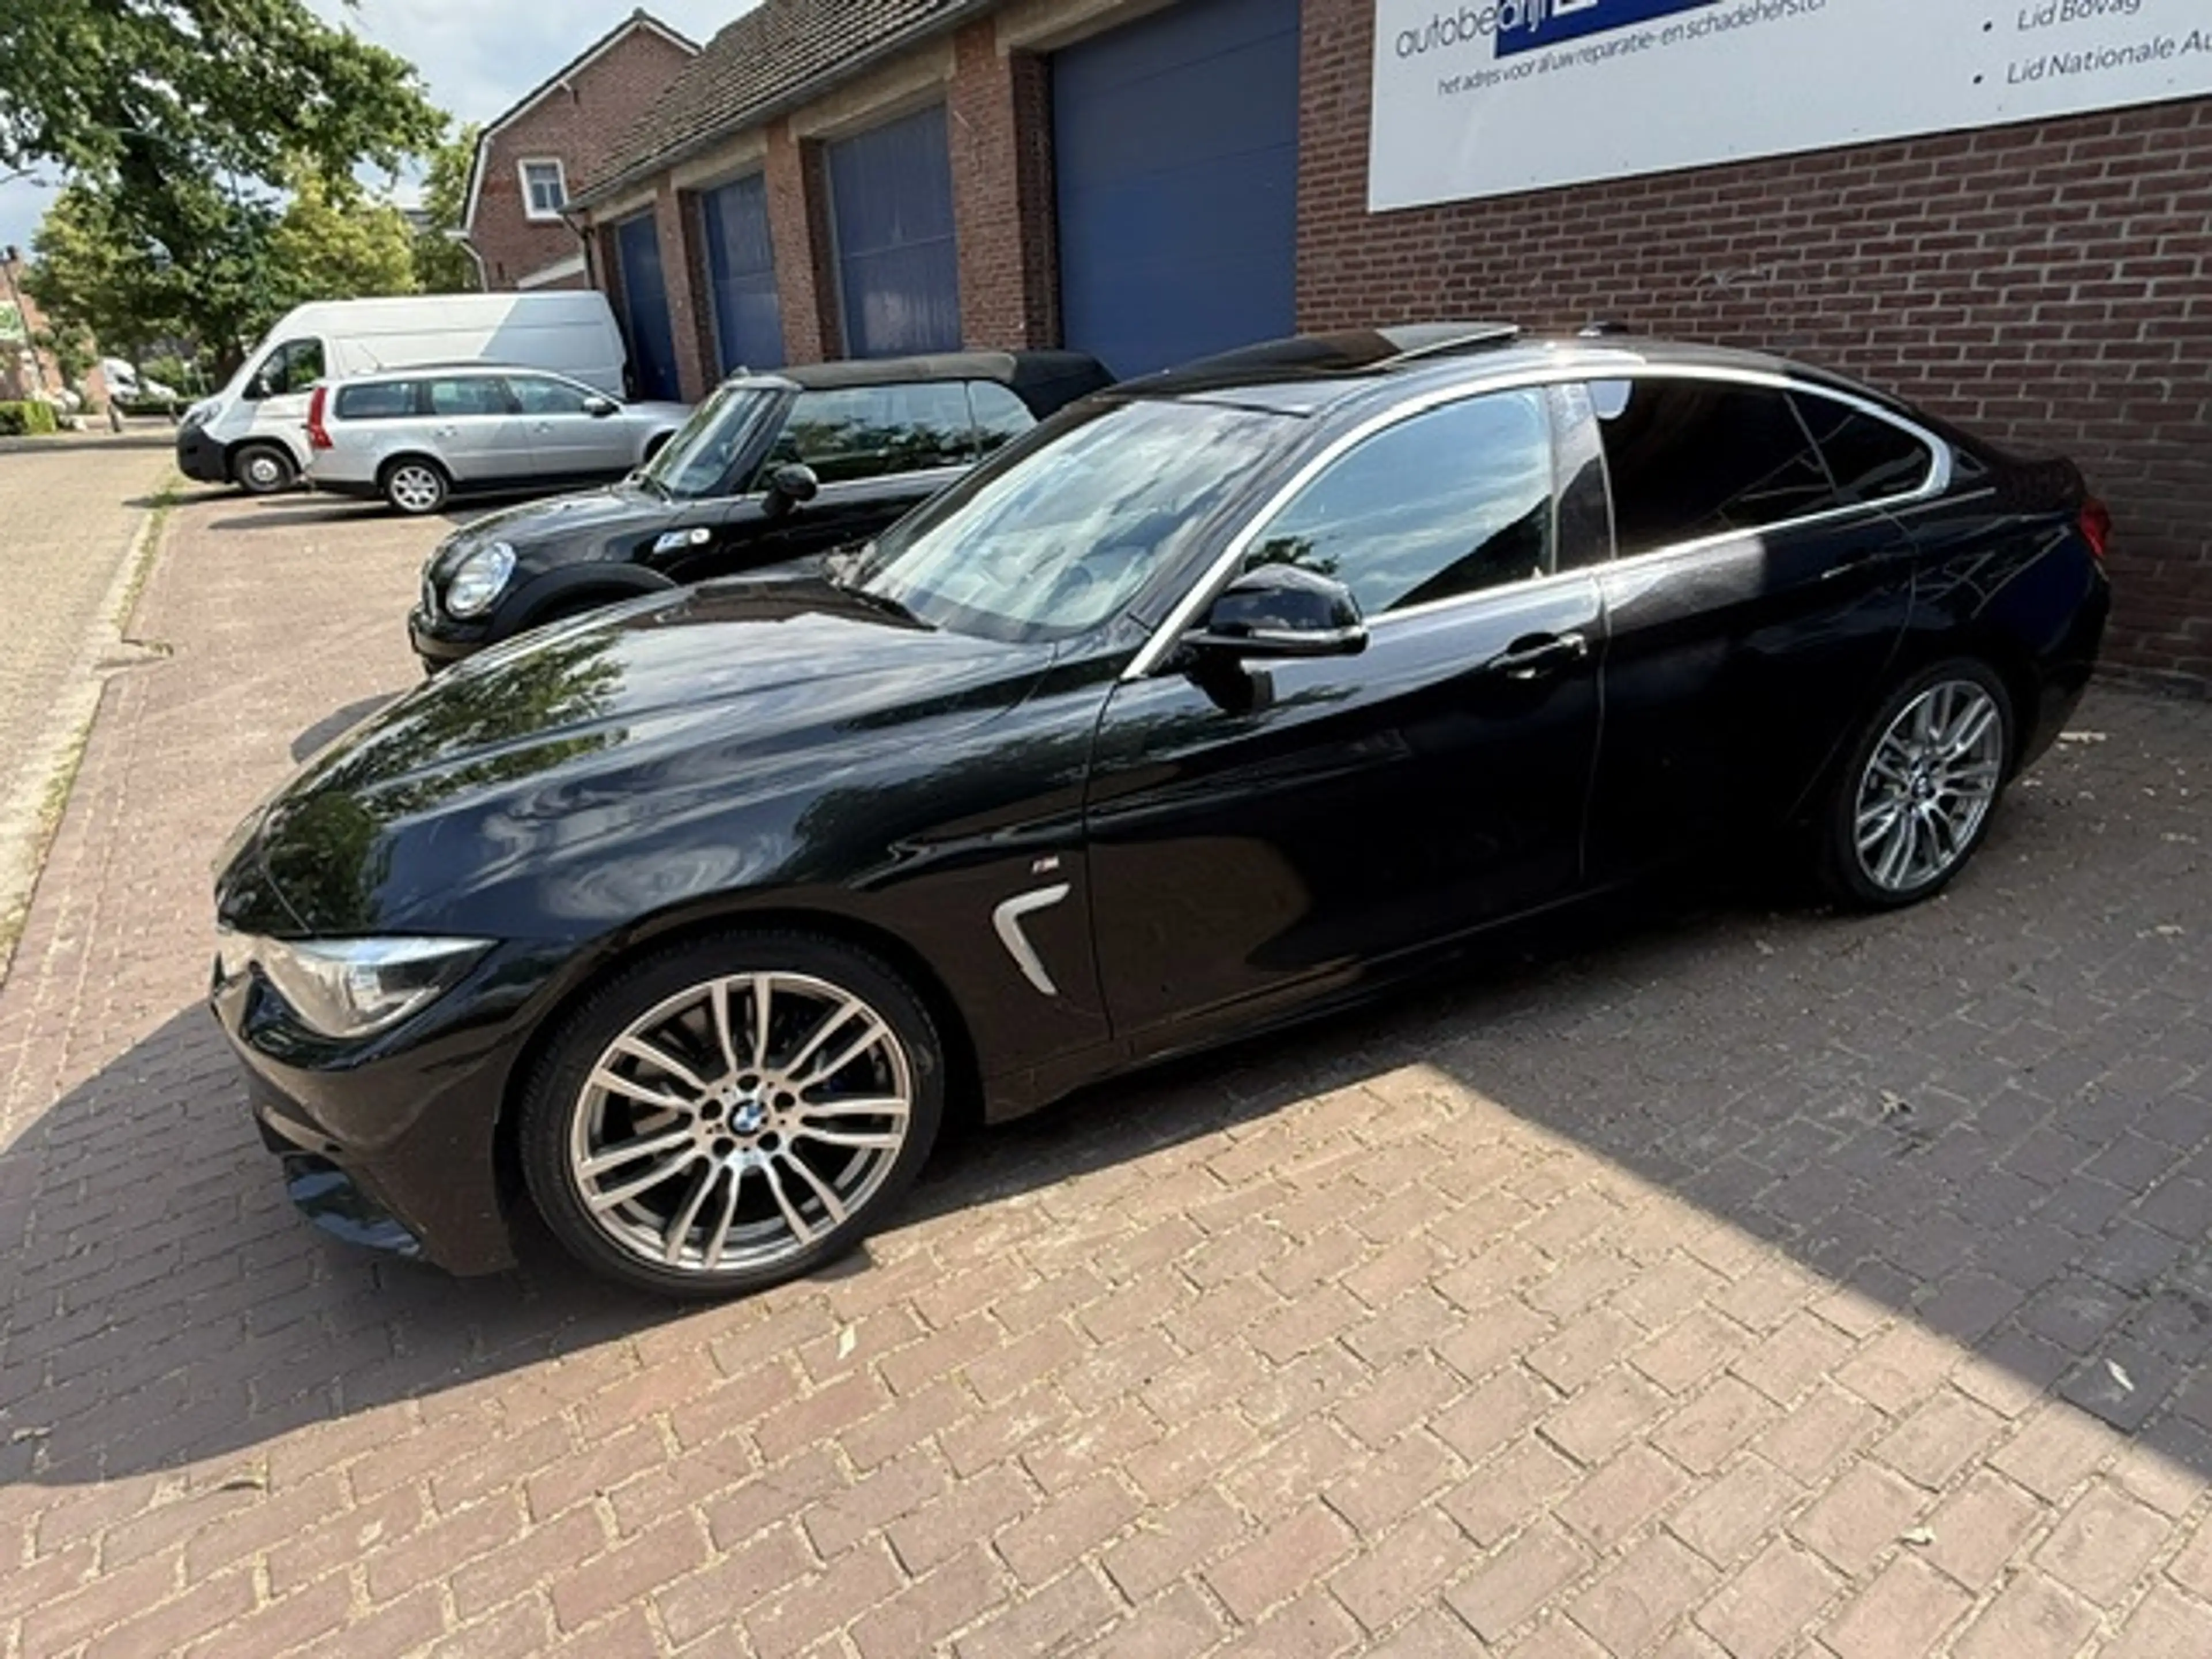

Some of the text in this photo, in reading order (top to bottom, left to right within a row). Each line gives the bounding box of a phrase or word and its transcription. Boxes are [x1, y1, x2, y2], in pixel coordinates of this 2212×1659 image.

[2018, 1, 2056, 31] Lid
[1502, 59, 1535, 81] voor
[2008, 55, 2046, 84] Lid
[2048, 35, 2175, 77] Nationale
